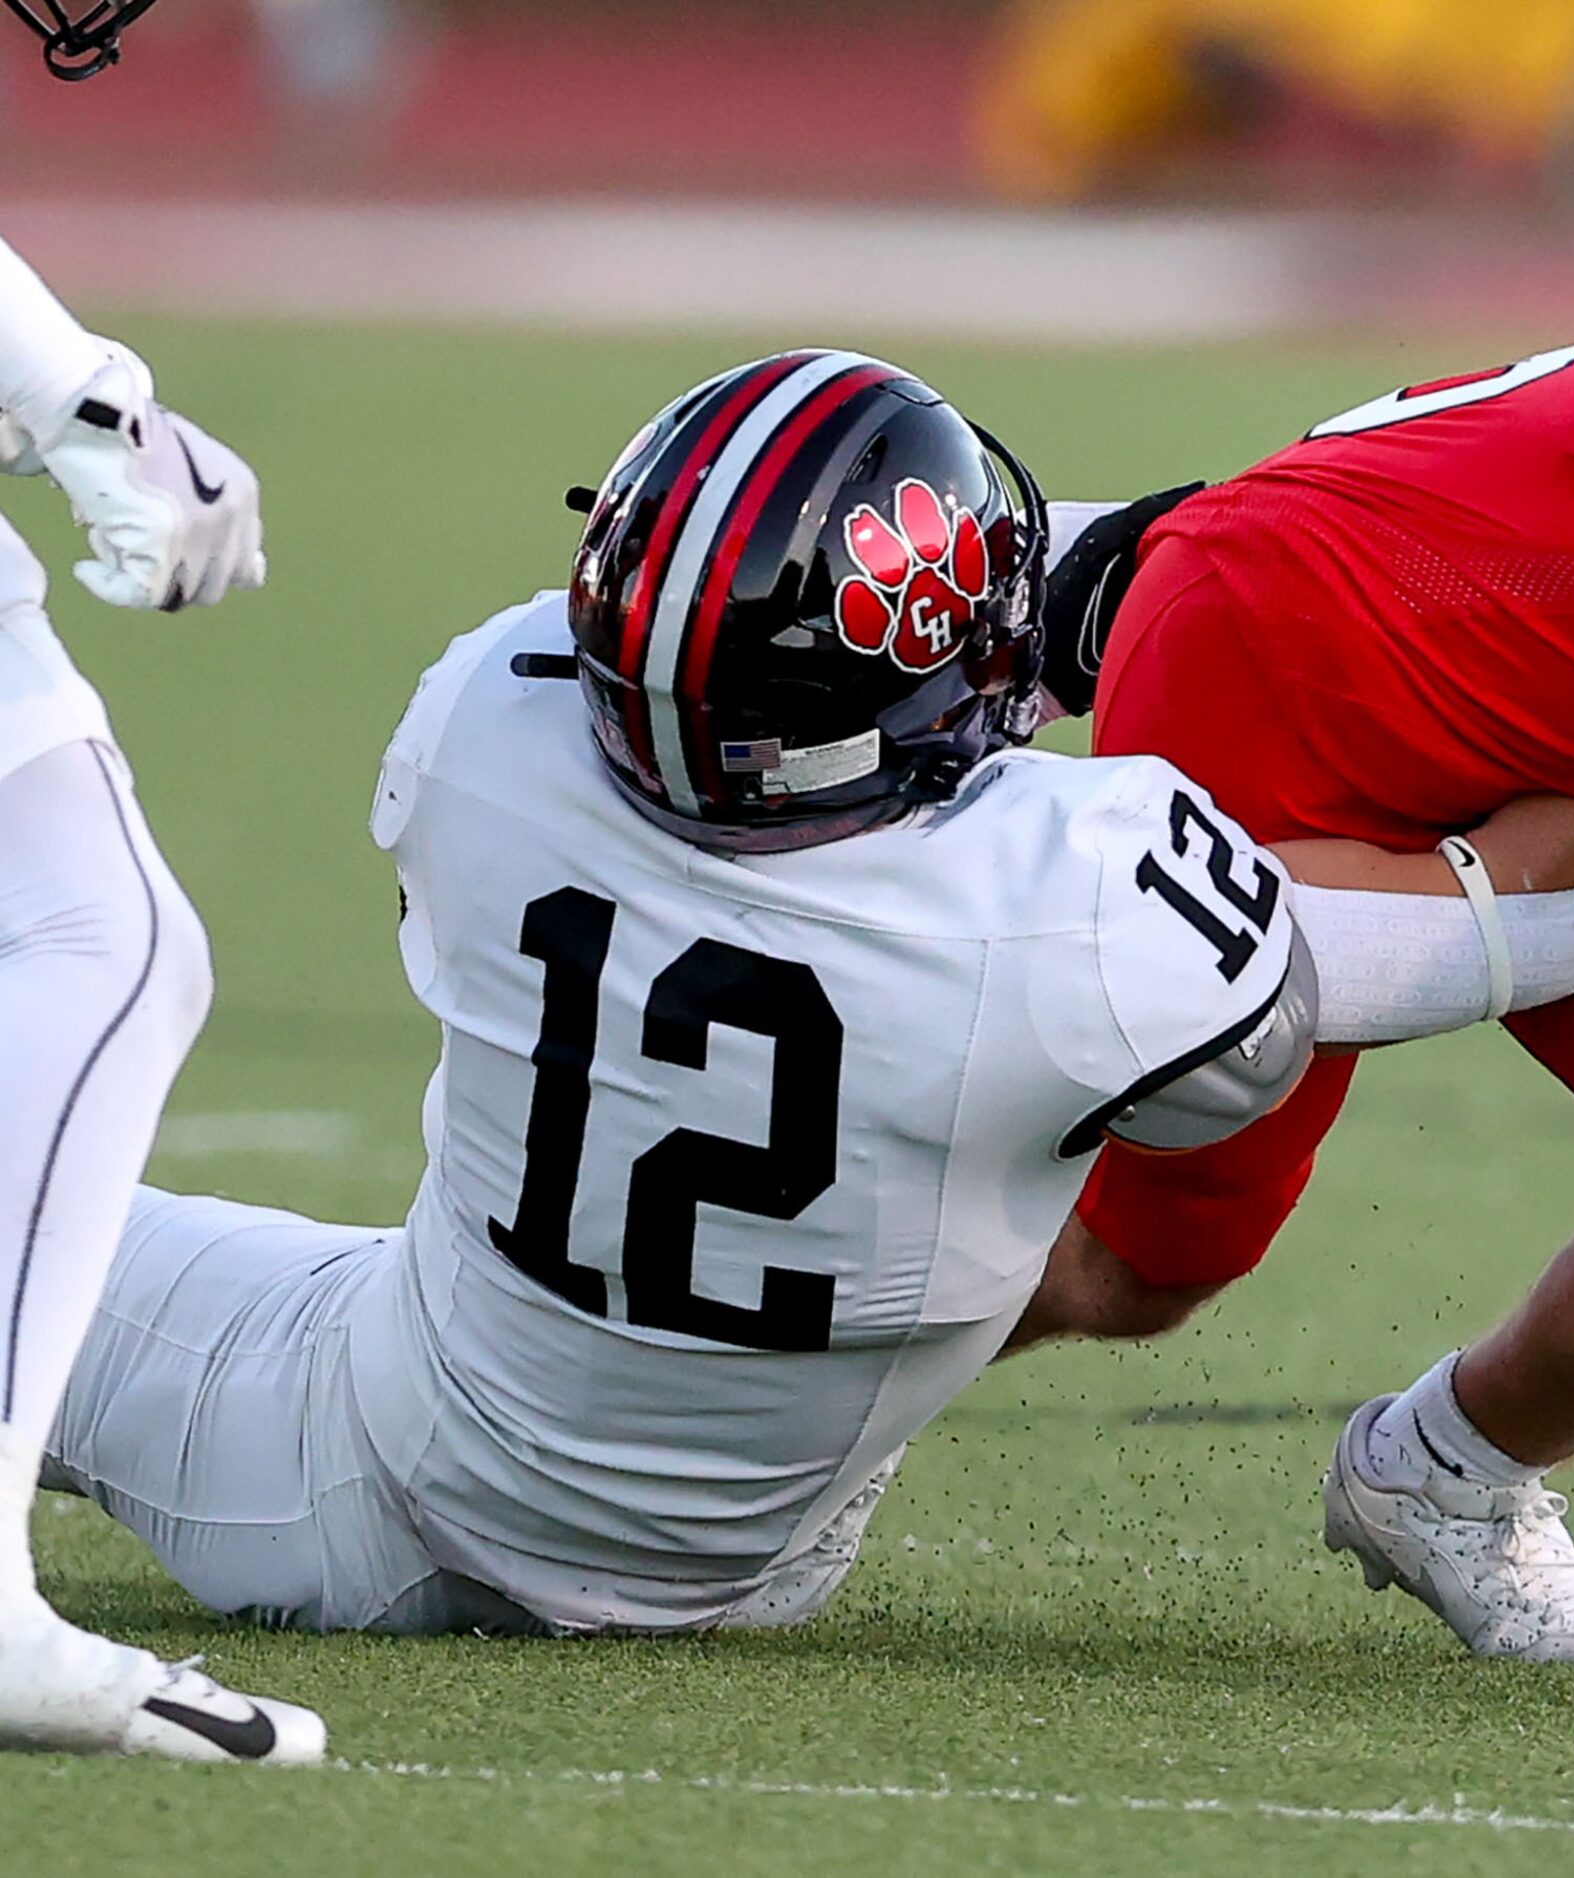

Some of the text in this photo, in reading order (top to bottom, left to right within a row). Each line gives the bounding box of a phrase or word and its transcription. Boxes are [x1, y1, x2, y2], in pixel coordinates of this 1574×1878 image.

[909, 595, 953, 654] CH
[1134, 788, 1281, 985] 12
[487, 885, 844, 1352] 12
